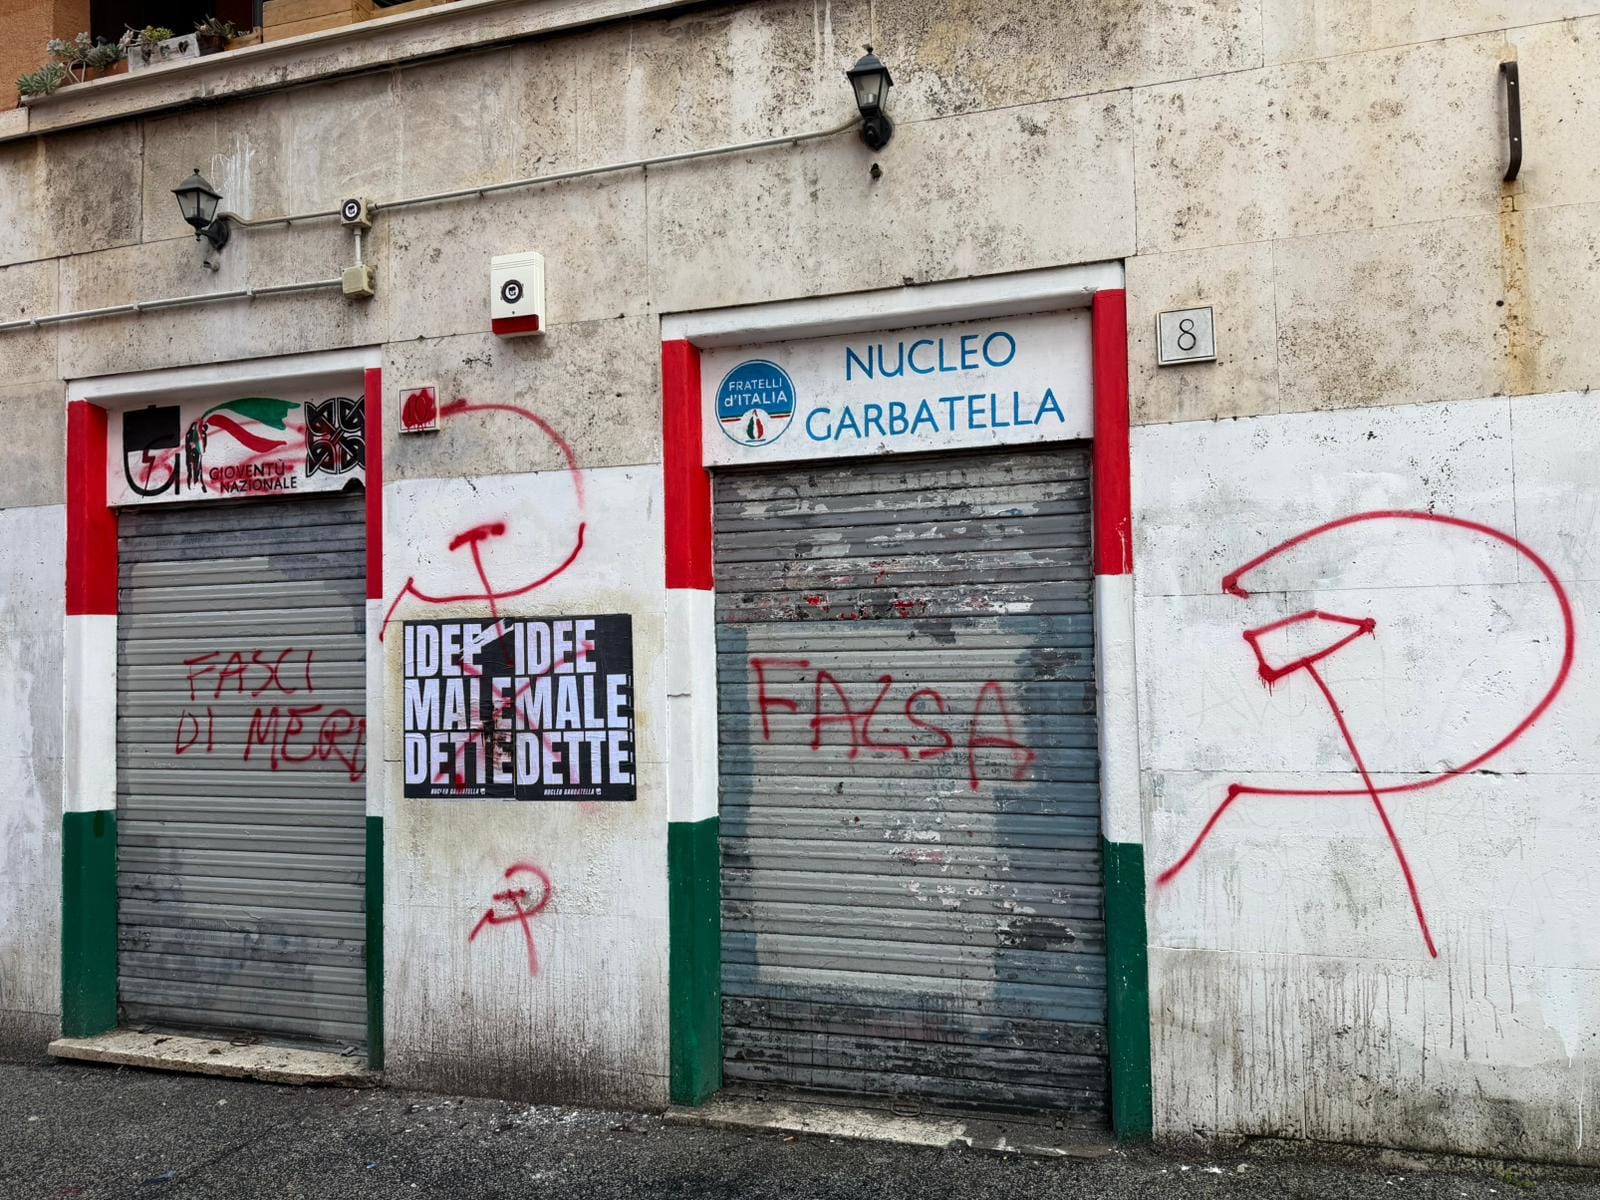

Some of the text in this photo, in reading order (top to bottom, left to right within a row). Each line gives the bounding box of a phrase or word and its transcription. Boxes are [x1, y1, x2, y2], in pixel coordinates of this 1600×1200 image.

[845, 331, 1016, 381] NUCLEO
[1177, 318, 1197, 351] 8
[724, 390, 788, 407] d'ITALIA
[729, 377, 782, 392] FRATELLI
[805, 387, 1065, 442] GARBATELLA
[209, 459, 285, 481] GIOVENTÙ
[220, 476, 298, 493] NAZIONALE
[404, 623, 483, 677] IDEE
[514, 619, 597, 675] IDEE
[183, 647, 314, 701] FASCI
[404, 677, 513, 730] MALE
[515, 673, 629, 730] MALE
[750, 658, 1037, 791] FALSA
[175, 706, 215, 755] DI
[404, 731, 514, 785] DETTE
[515, 730, 631, 785] DETTE
